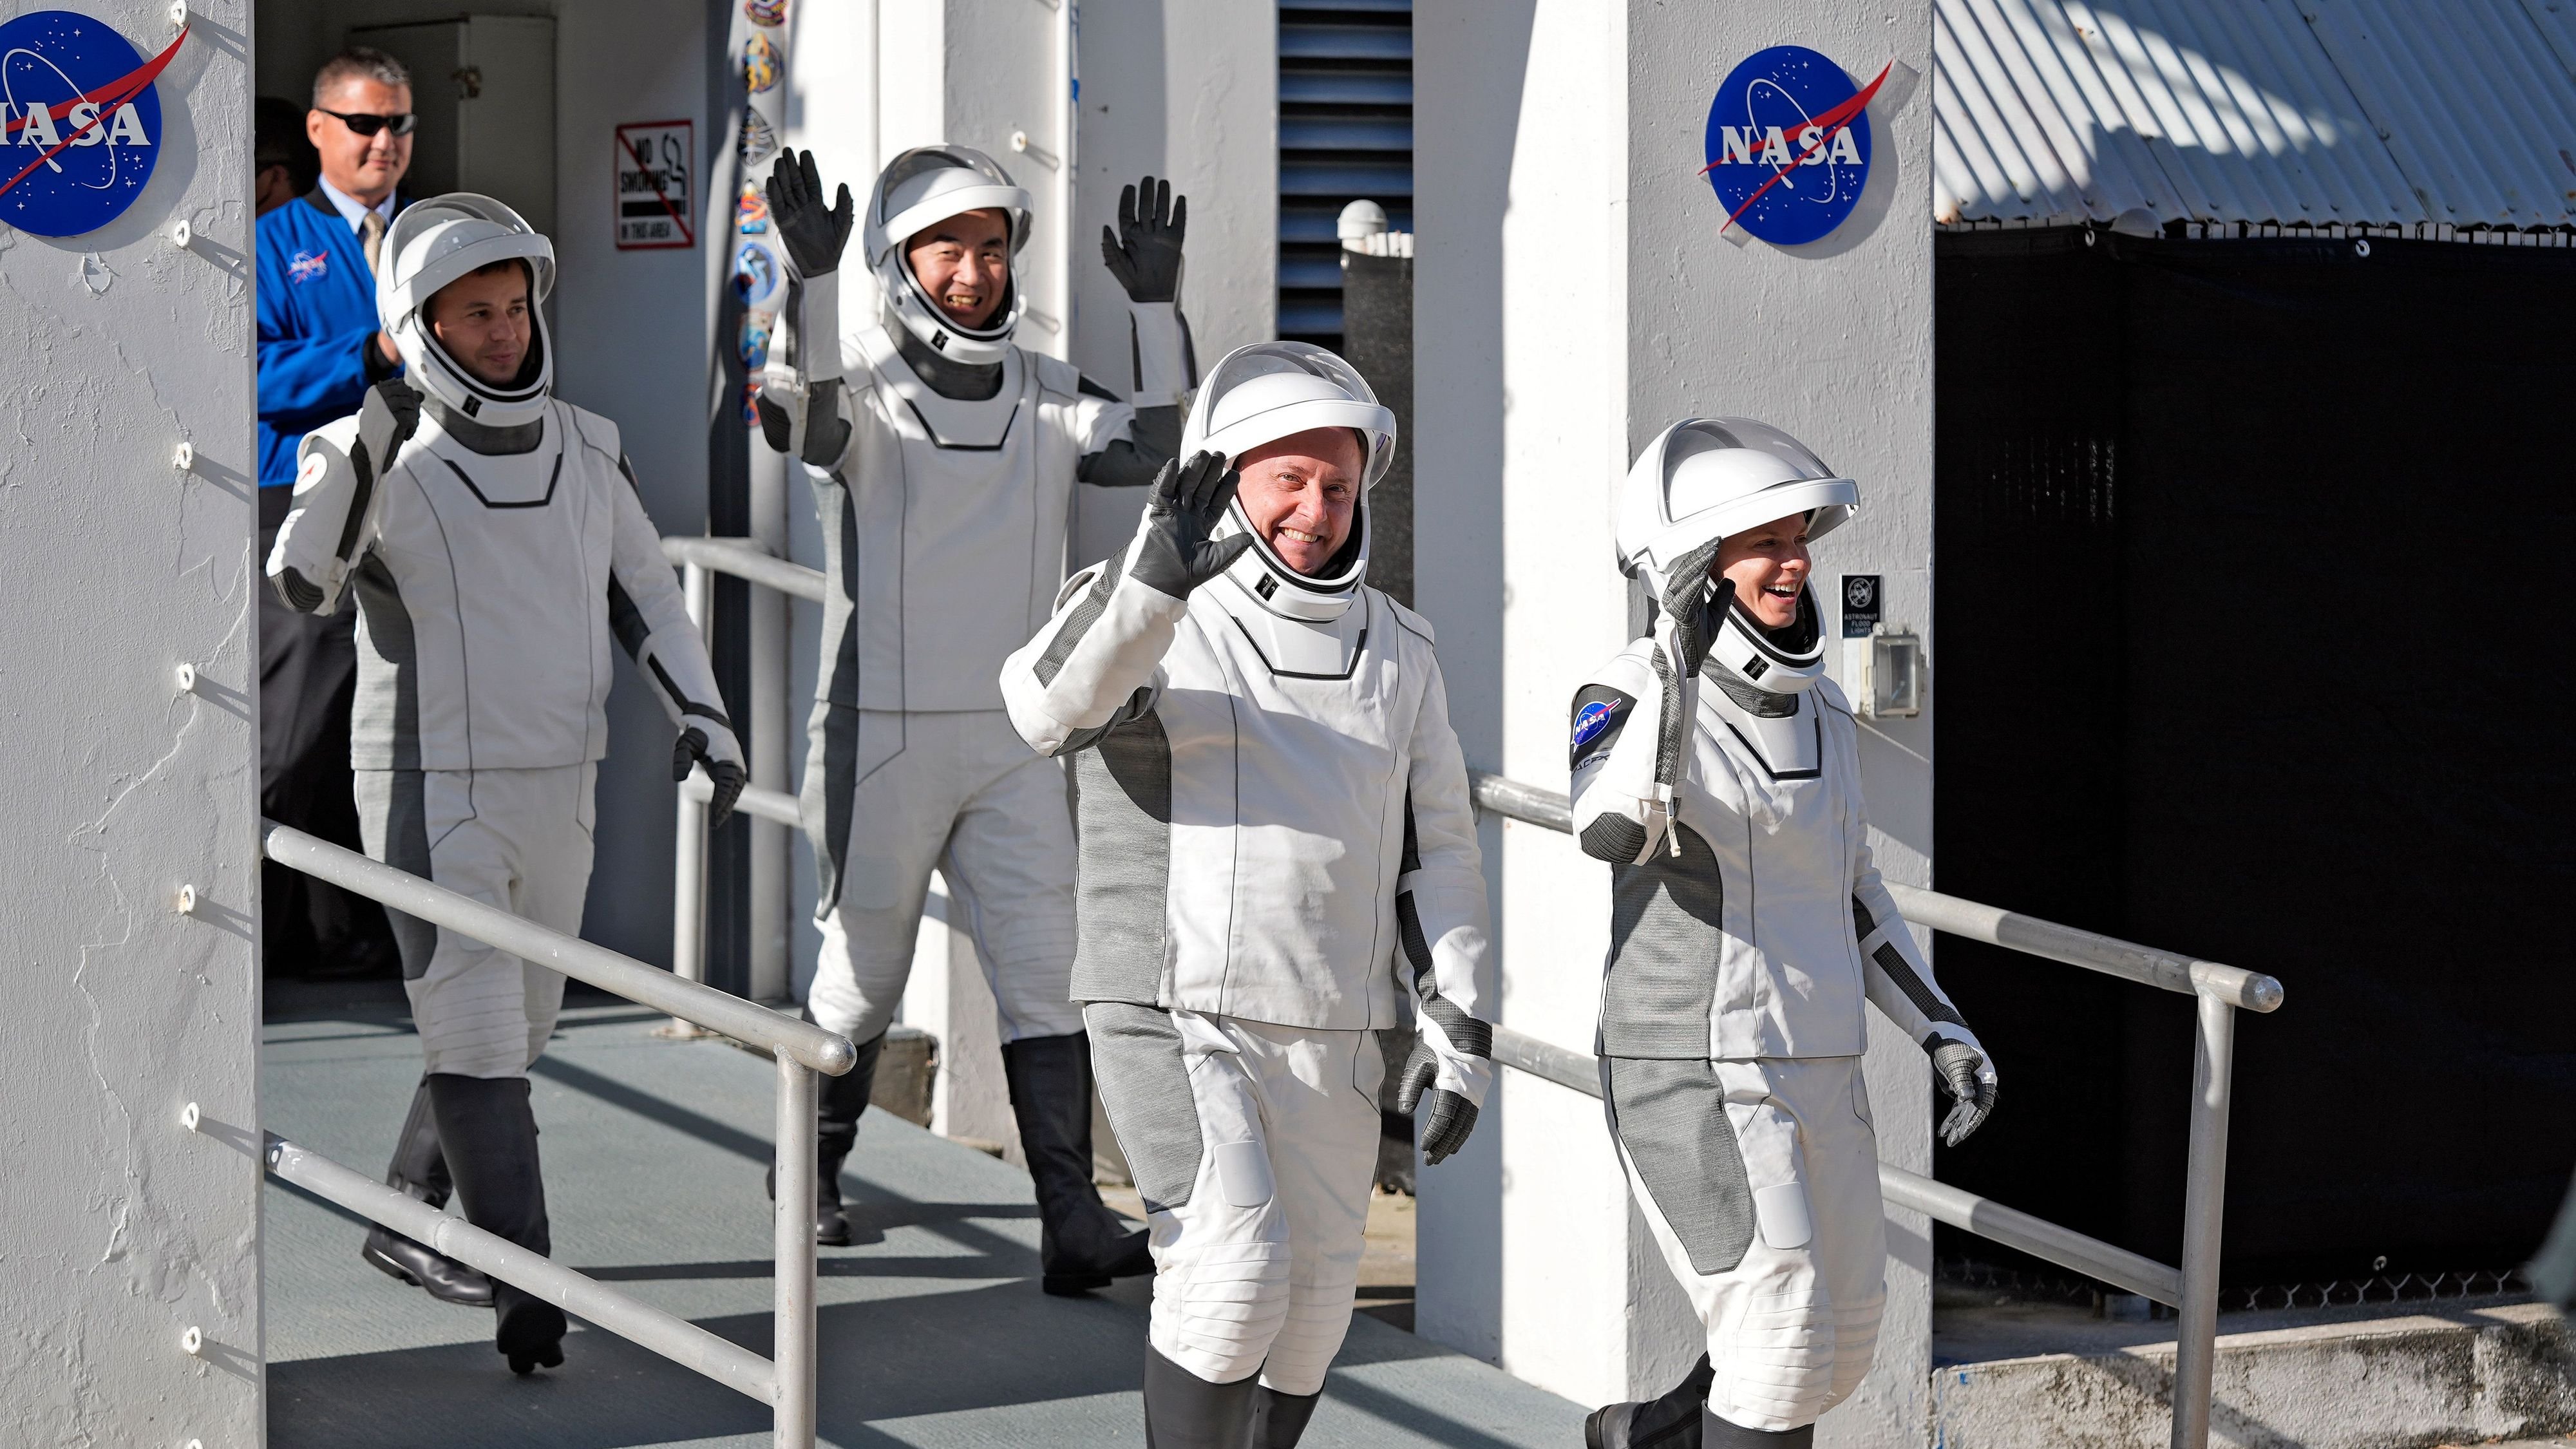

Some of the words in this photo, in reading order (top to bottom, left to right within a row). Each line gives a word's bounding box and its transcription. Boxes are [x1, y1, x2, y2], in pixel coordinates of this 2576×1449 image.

[0, 101, 152, 147] ASA
[636, 138, 652, 164] NO
[1720, 126, 1863, 166] NASA
[1575, 714, 1605, 734] NASA
